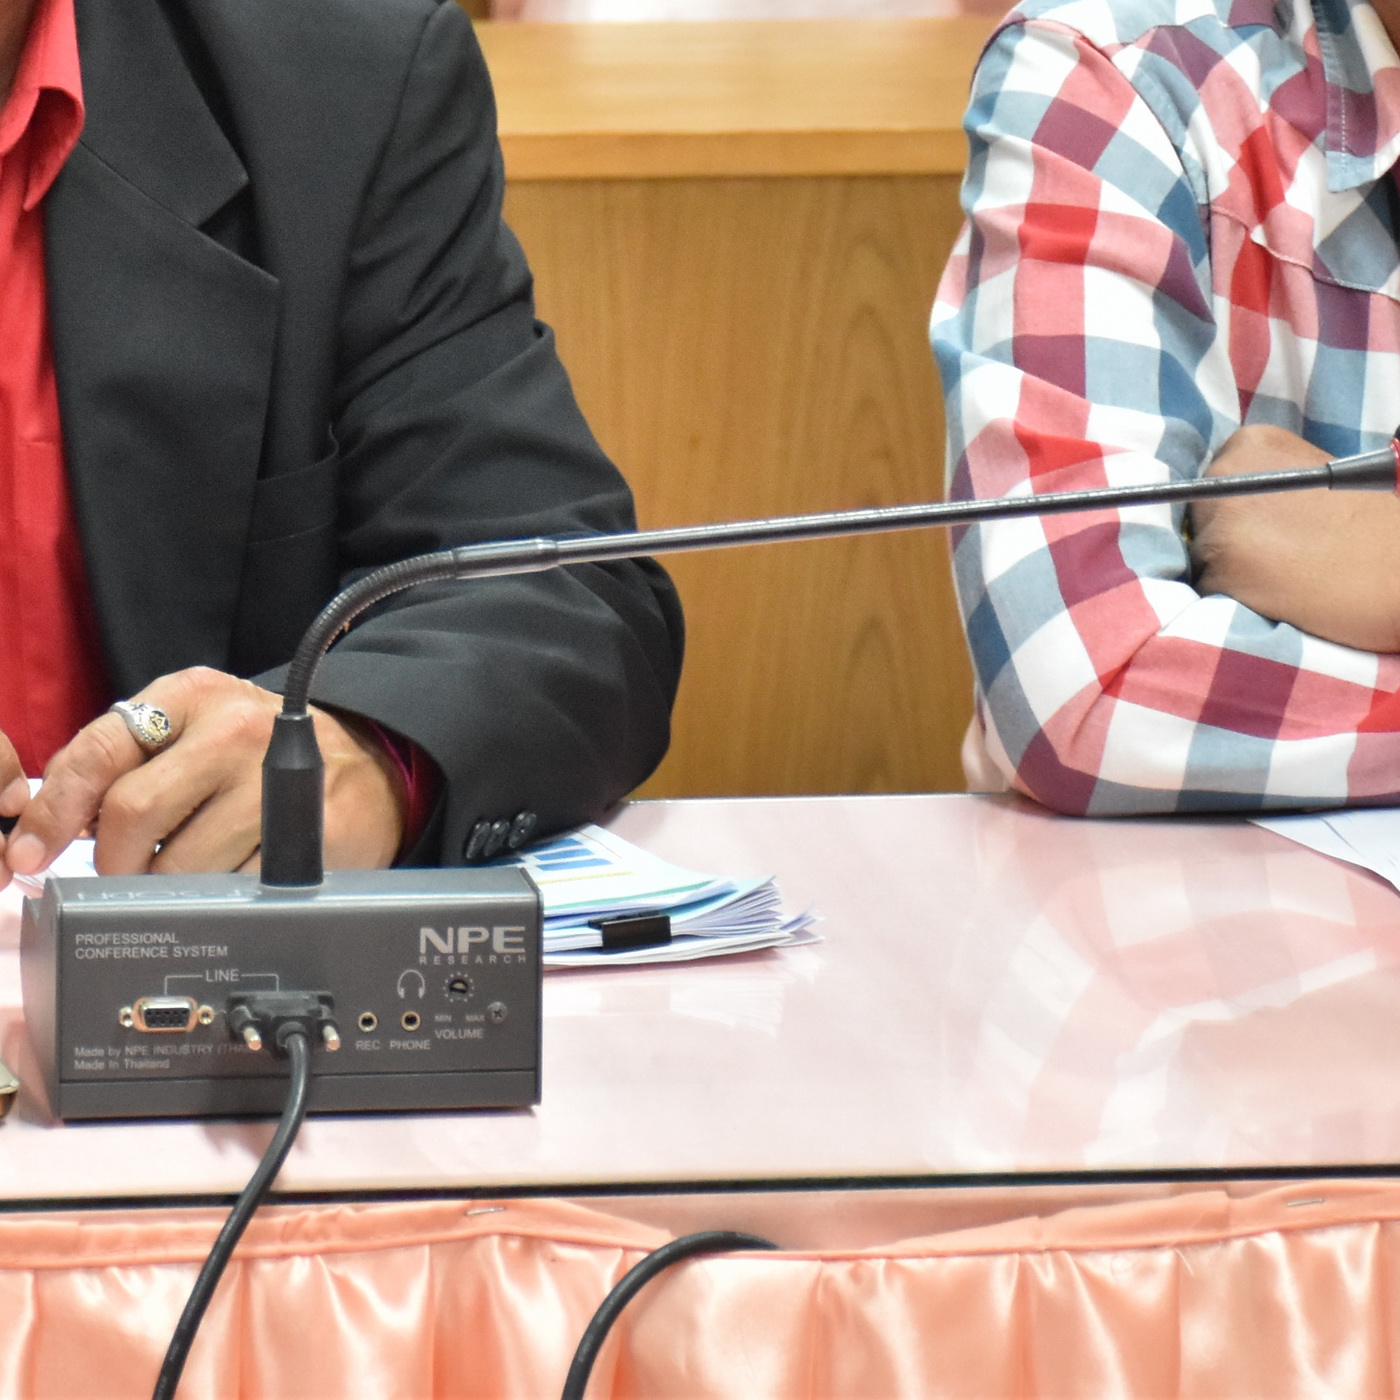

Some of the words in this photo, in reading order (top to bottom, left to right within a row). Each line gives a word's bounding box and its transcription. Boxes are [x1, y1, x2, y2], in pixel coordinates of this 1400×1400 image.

[75, 932, 179, 946] PROFESSIONAL
[419, 926, 526, 954] NPE
[75, 946, 168, 960] CONFERENCE
[173, 945, 228, 958] SYSTEM
[419, 955, 526, 965] RESEARCH
[205, 969, 240, 983] LINE
[435, 1028, 484, 1040] VOLUME
[75, 1046, 104, 1057] Made
[108, 1046, 121, 1058] by
[125, 1045, 149, 1056] NPE
[356, 1040, 381, 1051] REC
[389, 1039, 431, 1051] PHONE
[74, 1059, 105, 1070] Made
